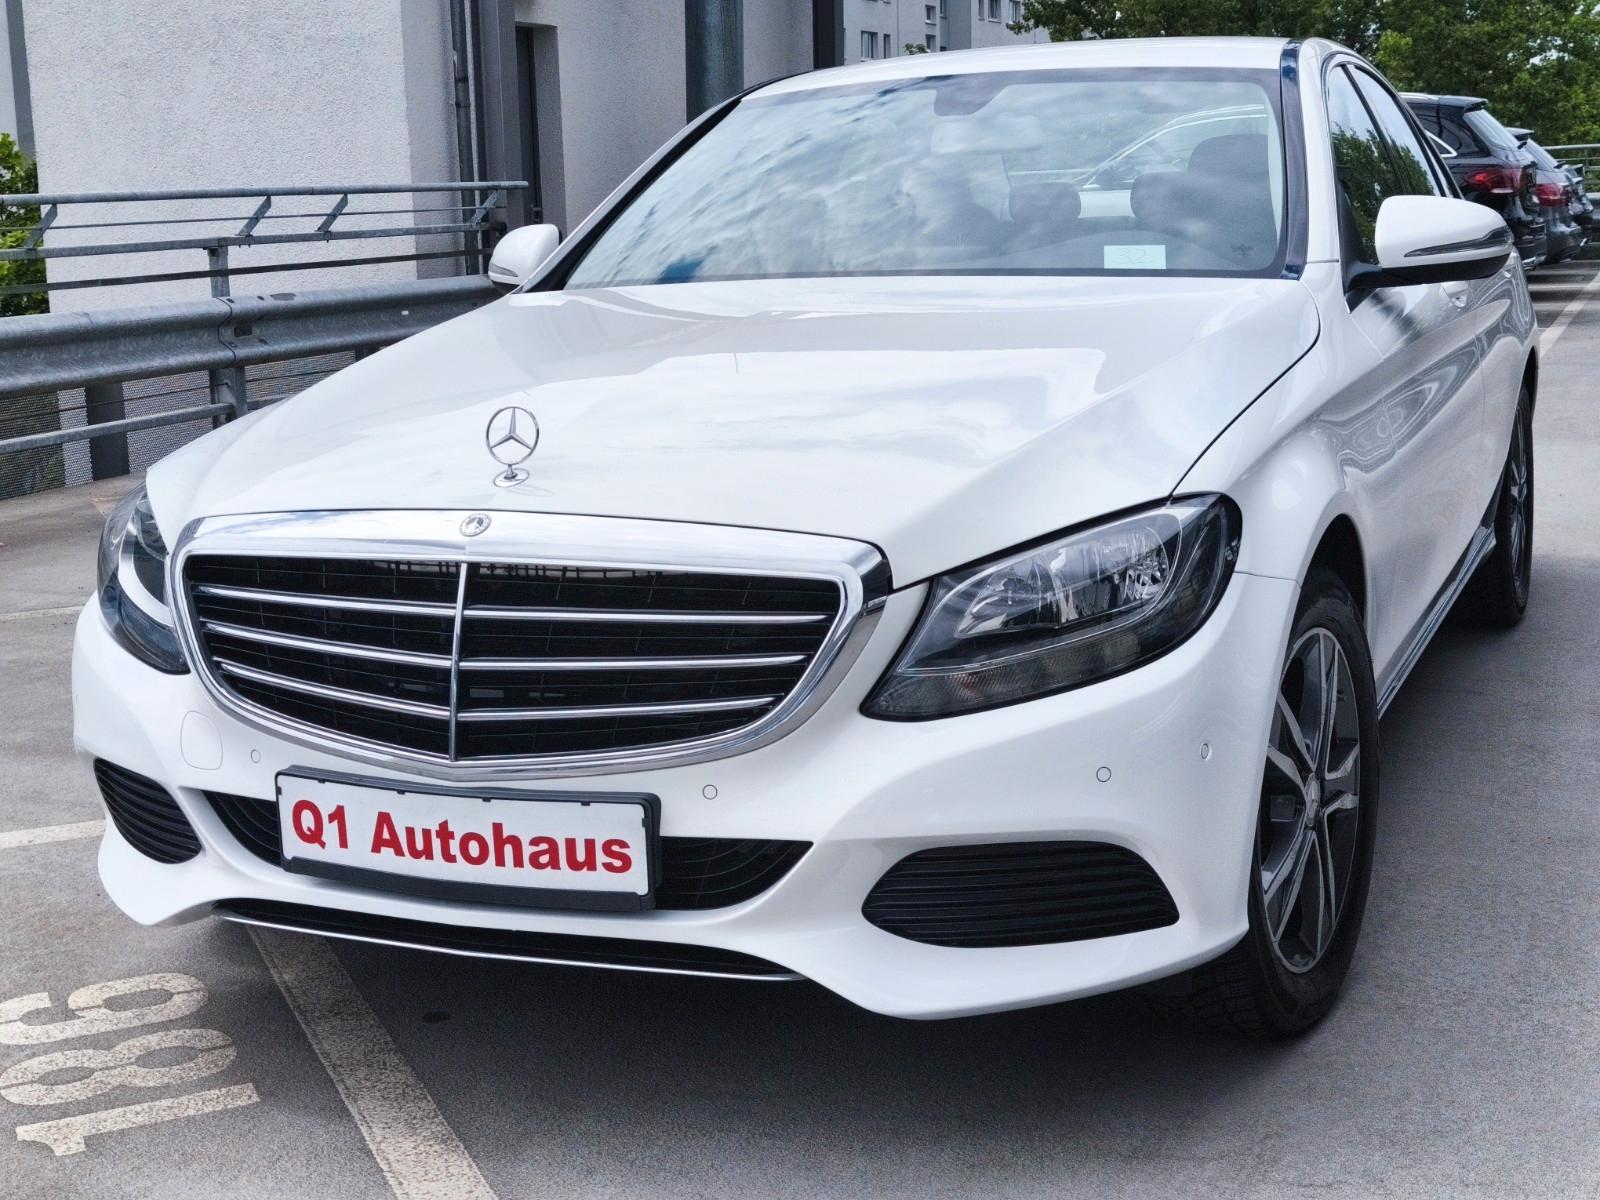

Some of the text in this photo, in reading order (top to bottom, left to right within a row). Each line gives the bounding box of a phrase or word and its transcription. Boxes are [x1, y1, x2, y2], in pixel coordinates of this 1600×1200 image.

[291, 799, 633, 874] Q1 Autohaus
[0, 972, 261, 1156] 186
